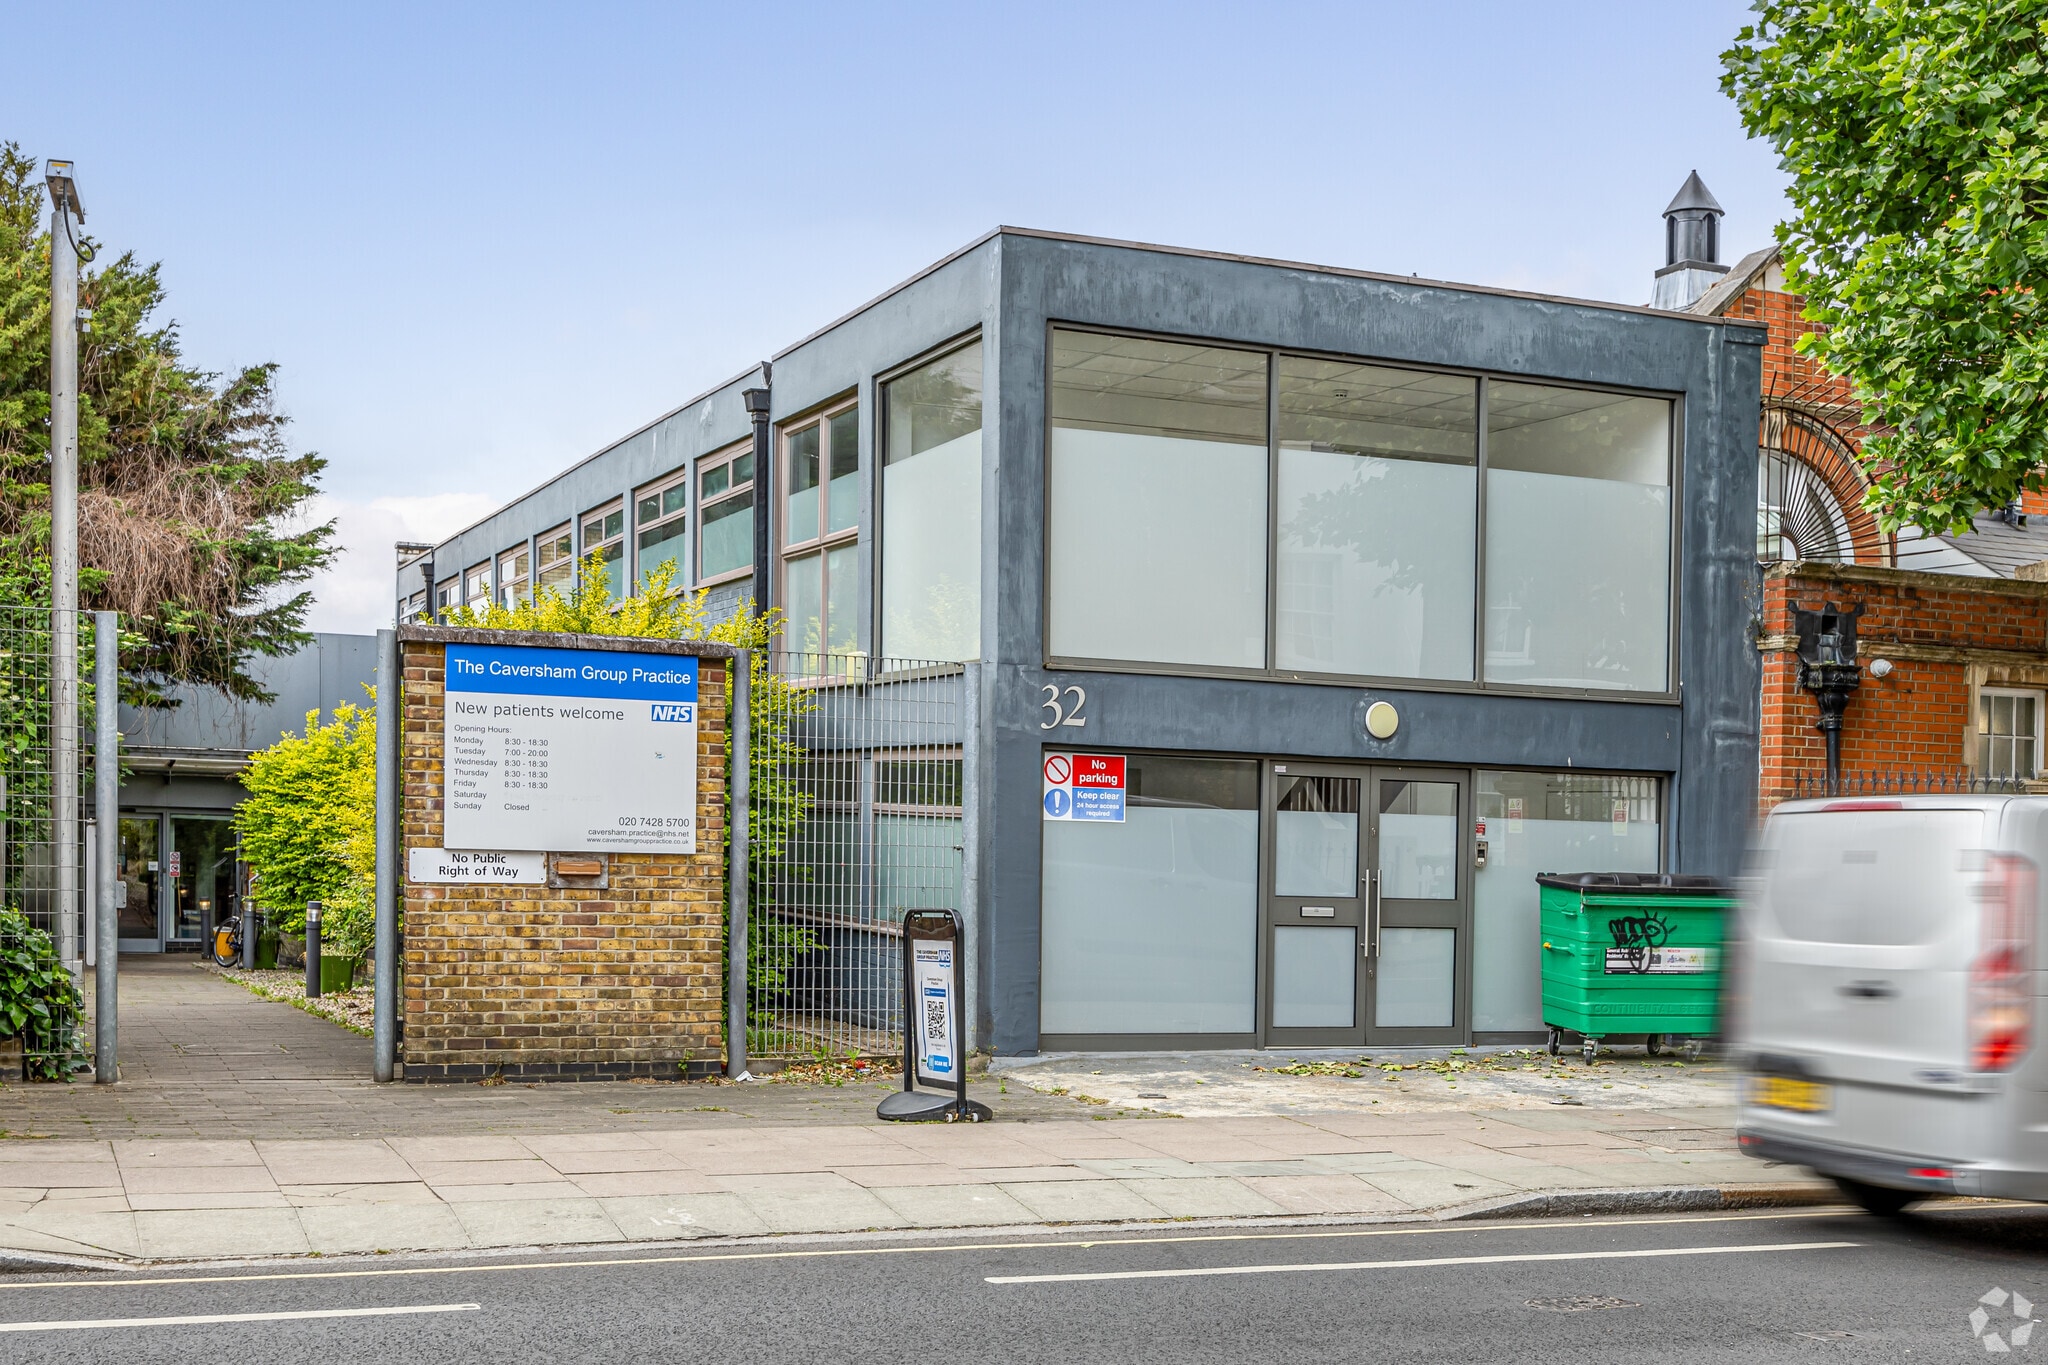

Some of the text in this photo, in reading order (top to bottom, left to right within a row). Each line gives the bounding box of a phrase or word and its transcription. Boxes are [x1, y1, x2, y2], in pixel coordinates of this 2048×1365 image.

[454, 659, 691, 684] The Caversham Group Practice
[455, 701, 625, 720] New patients welcome
[1040, 684, 1086, 730] 32
[652, 705, 691, 722] NHS
[454, 724, 512, 734] Opening Hours:
[453, 736, 484, 746] Monday
[504, 738, 521, 746] 8:30
[528, 739, 549, 747] 18:30
[454, 746, 486, 757] Tuesday
[504, 749, 521, 757] 7:00
[527, 749, 549, 758] 20:00
[454, 757, 498, 768] Wednesday
[504, 760, 521, 768] 8:30
[528, 760, 548, 768] 18:30
[1091, 759, 1107, 770] No
[454, 768, 489, 778] Thursday
[504, 770, 521, 778] 8:30
[528, 771, 548, 779] 18:30
[453, 779, 477, 789] Friday
[504, 781, 521, 789] 8:30
[528, 782, 548, 790] 18:30
[1079, 773, 1118, 786] parking
[453, 790, 487, 800] Saturday
[1077, 791, 1120, 801] Keep clear
[453, 801, 530, 812] Sunday Closed
[1086, 810, 1111, 818] required
[618, 816, 690, 828] 020 7428 5700
[587, 829, 690, 839] caversham.practice@nhs.net
[586, 837, 690, 845] www.cavershamgrouppractice.co.uk
[451, 853, 507, 865] No Public
[439, 865, 519, 880] Right of Way
